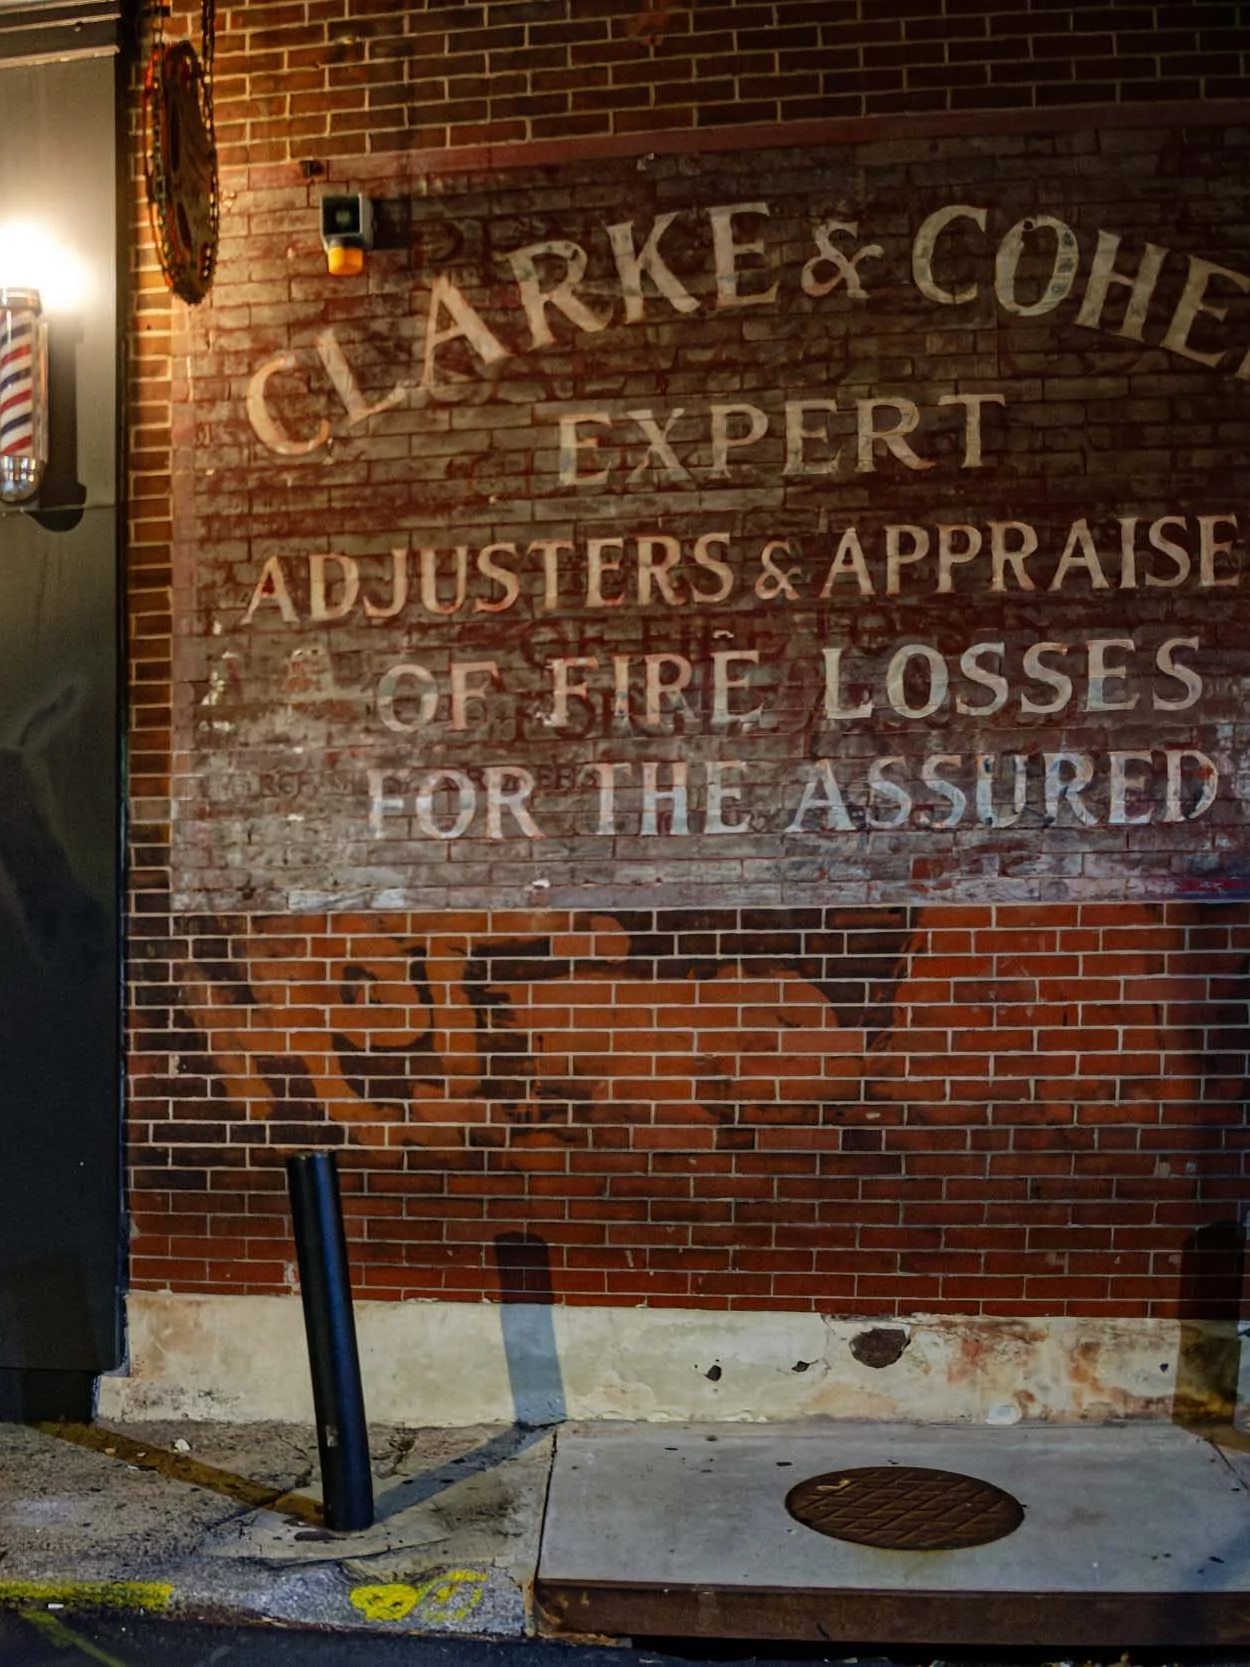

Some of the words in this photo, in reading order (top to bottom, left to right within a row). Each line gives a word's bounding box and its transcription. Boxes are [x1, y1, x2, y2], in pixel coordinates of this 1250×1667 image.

[246, 202, 780, 456] CLARKE
[801, 218, 884, 299] &
[911, 204, 1250, 380] COHE
[559, 394, 1006, 488] EXPERT
[239, 532, 735, 625] ADJUSTERS
[754, 540, 802, 600] &
[818, 512, 1240, 599] APPRAISE
[376, 662, 500, 733] OF
[549, 650, 764, 730] FIRE
[821, 636, 1203, 720] LOSSES
[366, 764, 547, 841] FOR
[592, 759, 751, 837] THE
[784, 748, 1219, 834] ASSURED
